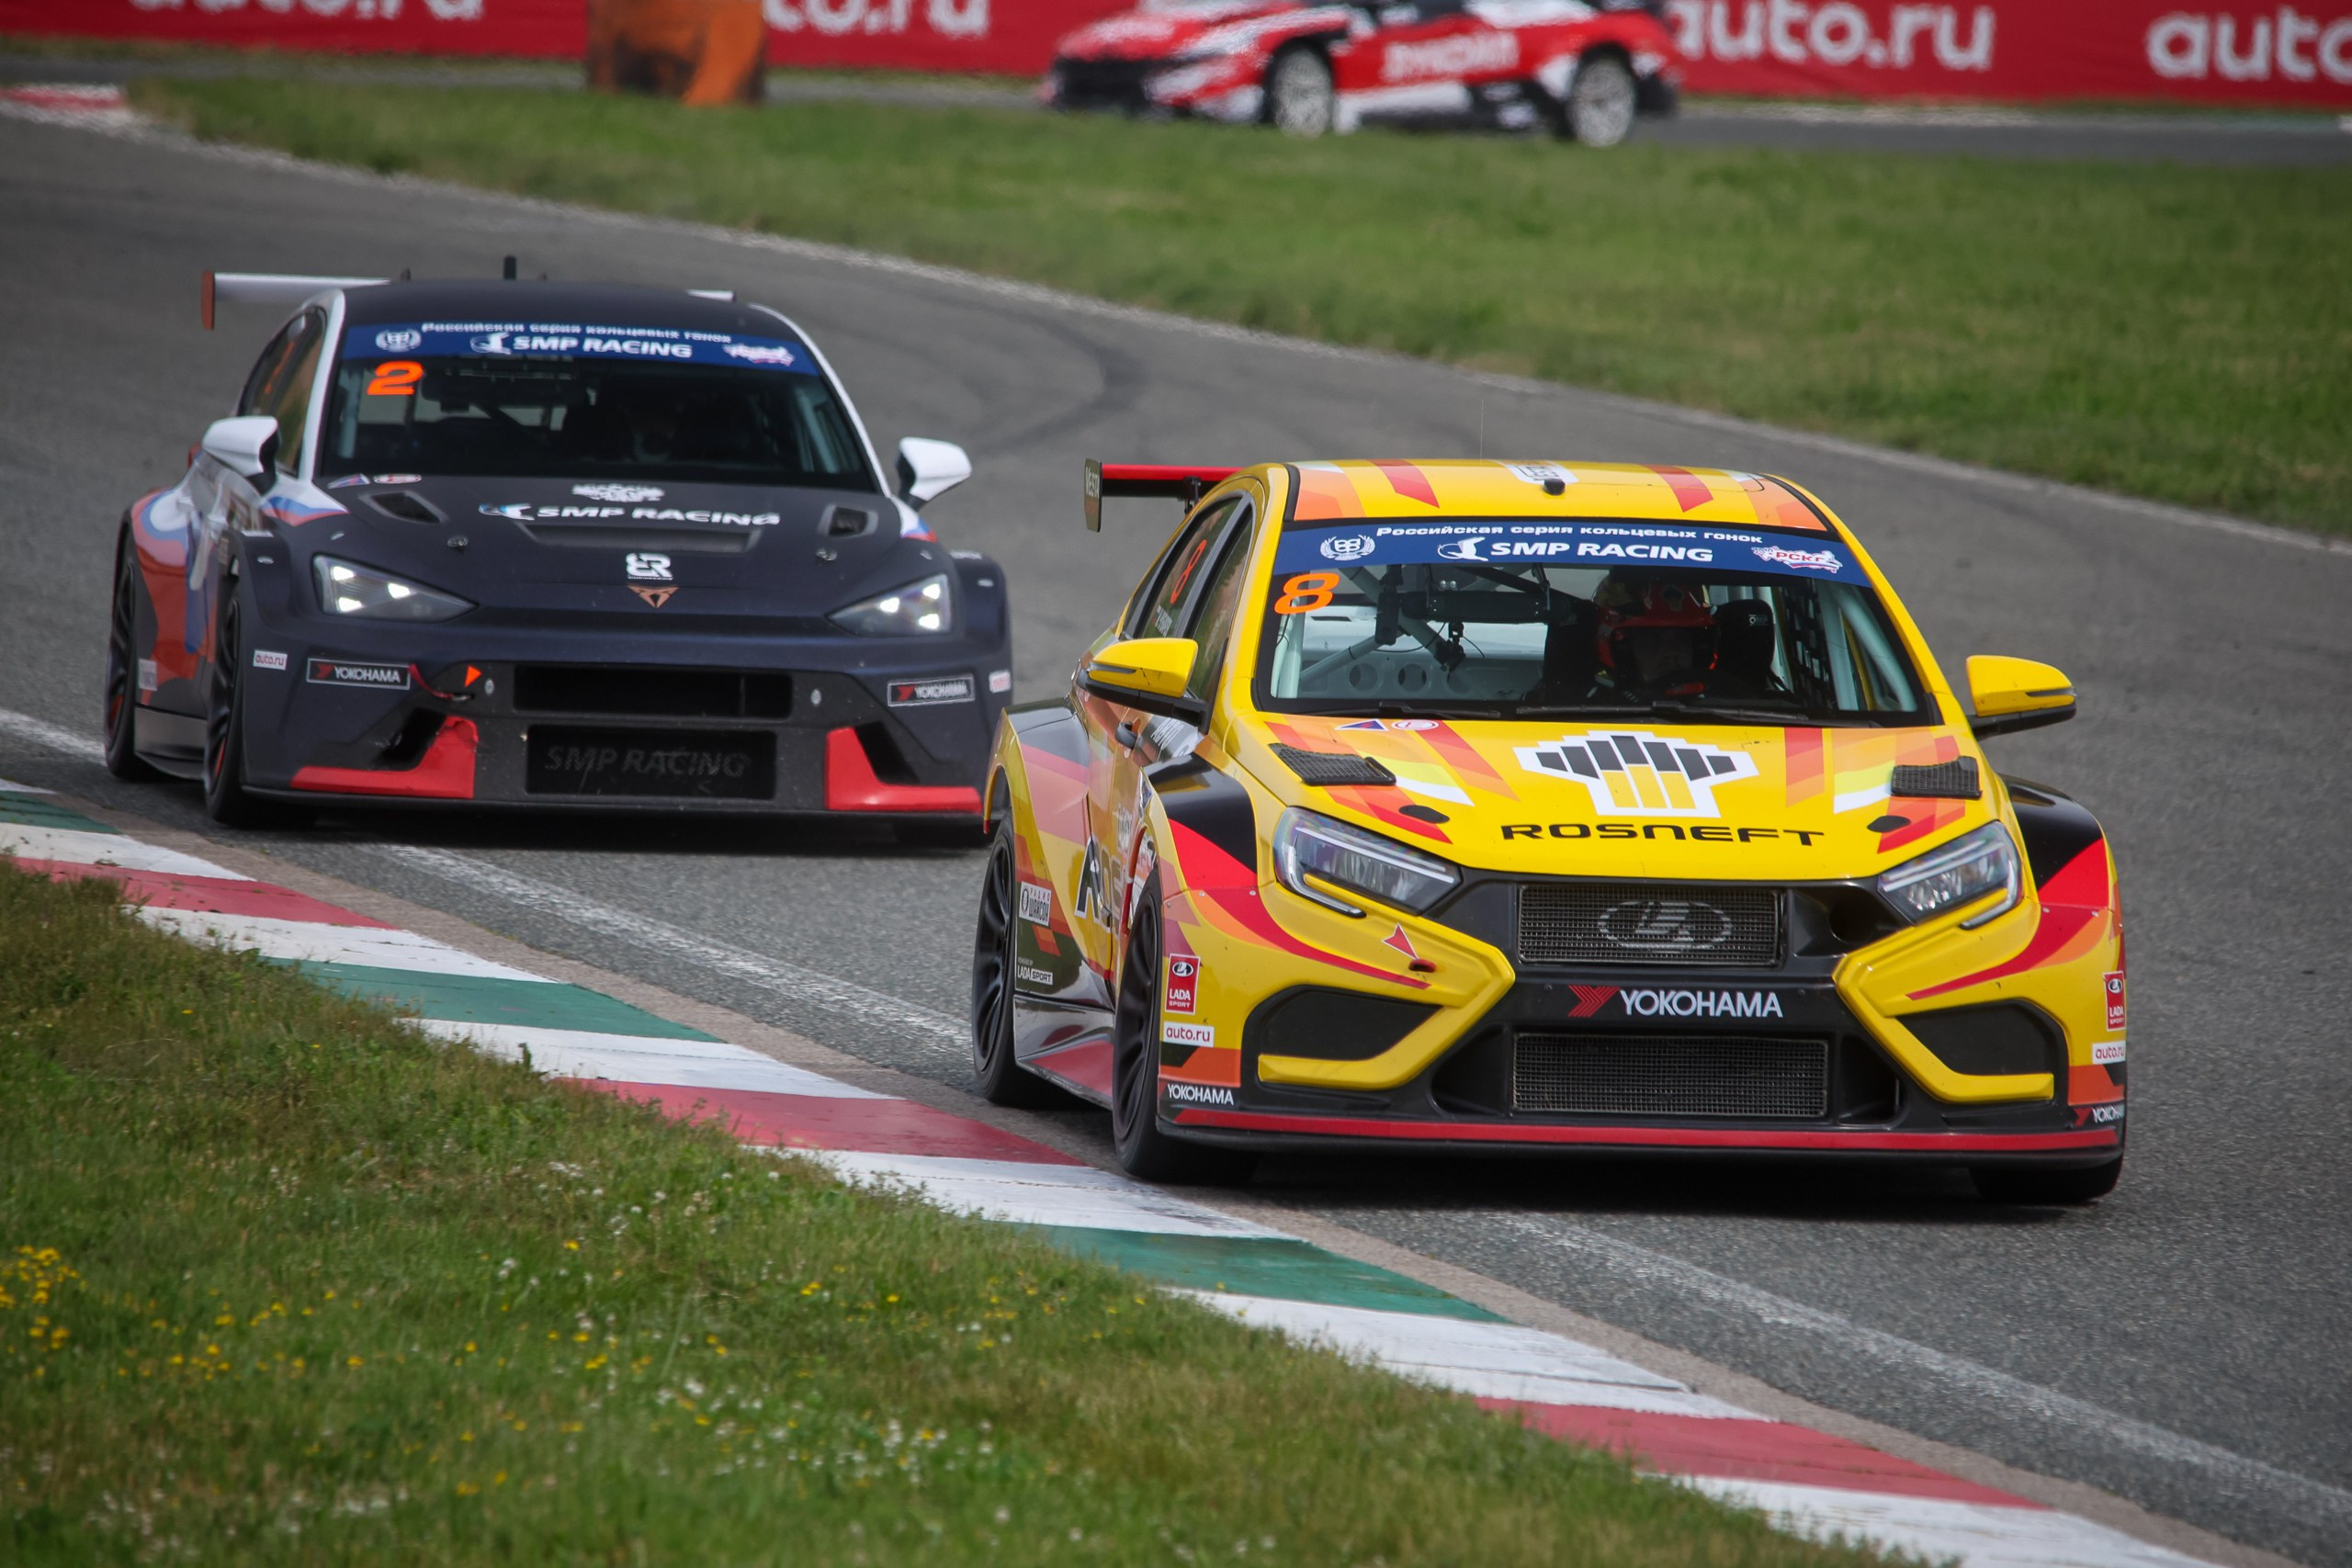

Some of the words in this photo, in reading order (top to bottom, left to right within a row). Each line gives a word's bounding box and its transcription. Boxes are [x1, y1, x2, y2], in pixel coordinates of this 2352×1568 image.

[513, 335, 580, 352] SMP
[582, 337, 694, 358] RACING
[368, 360, 424, 395] 2
[537, 506, 626, 518] SMP
[631, 507, 781, 527] RACING
[1375, 525, 1504, 537] Российская
[1510, 525, 1574, 536] серия
[1579, 526, 1698, 539] кольцевых
[1703, 531, 1764, 544] гонок
[1489, 541, 1570, 557] SMP
[1576, 542, 1714, 563] RACING
[1273, 572, 1340, 615] 8
[254, 653, 285, 666] auto.ru
[334, 664, 401, 682] YOKOHAMA
[545, 746, 617, 772] SMP
[622, 748, 752, 777] RACING
[1501, 823, 1825, 847] ROSNEFT
[1017, 965, 1031, 980] LADA
[1032, 971, 1052, 983] SPORT
[1169, 988, 1192, 1001] LADA
[1169, 1000, 1191, 1009] SPORT
[1620, 989, 1783, 1018] YOKOHAMA
[1166, 1027, 1211, 1043] auto.ru
[1167, 1083, 1234, 1106] YOKOHAMA
